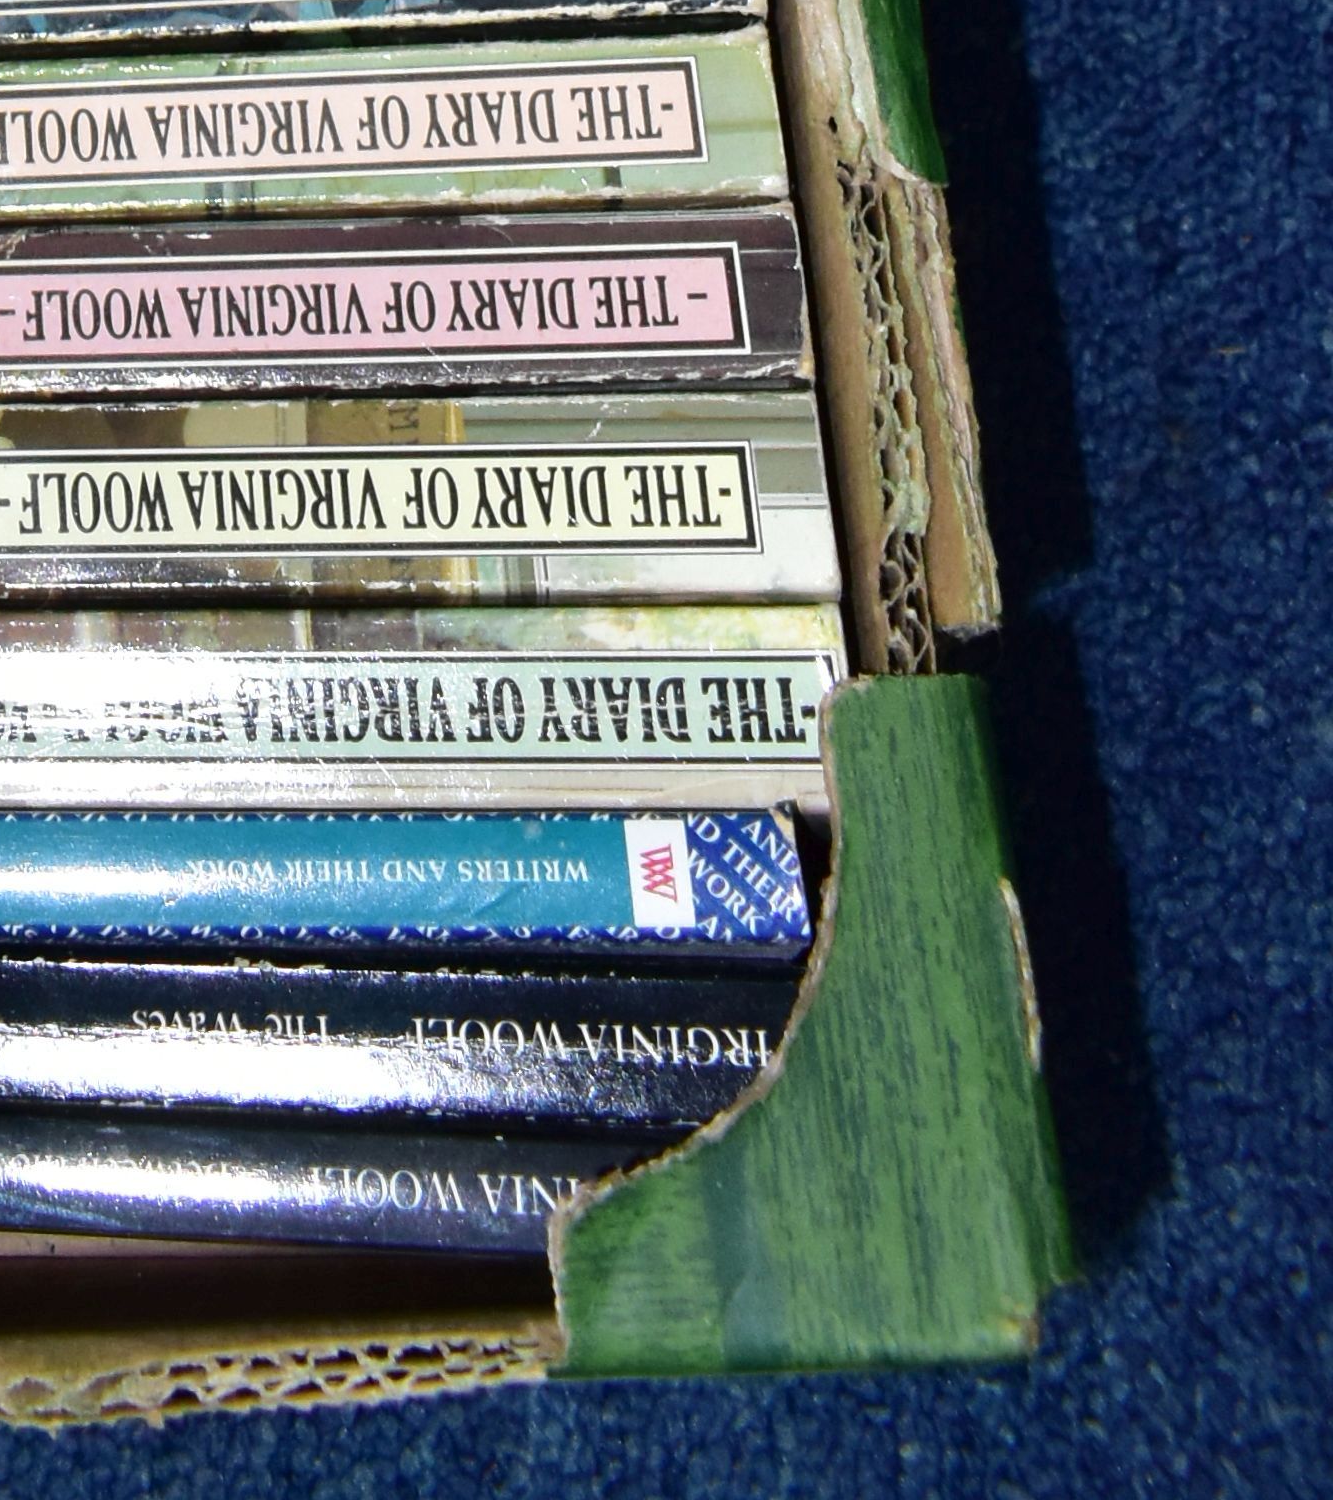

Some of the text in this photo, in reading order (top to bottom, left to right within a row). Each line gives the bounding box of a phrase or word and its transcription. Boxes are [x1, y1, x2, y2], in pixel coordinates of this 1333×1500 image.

[176, 280, 375, 340] VIRGINIA
[379, 280, 438, 336] OF
[446, 276, 579, 335] DIARY
[587, 273, 681, 330] THE
[183, 858, 277, 886] WORK
[283, 857, 380, 885] THEIR
[388, 857, 448, 884] AND
[455, 858, 591, 885] WRITERS
